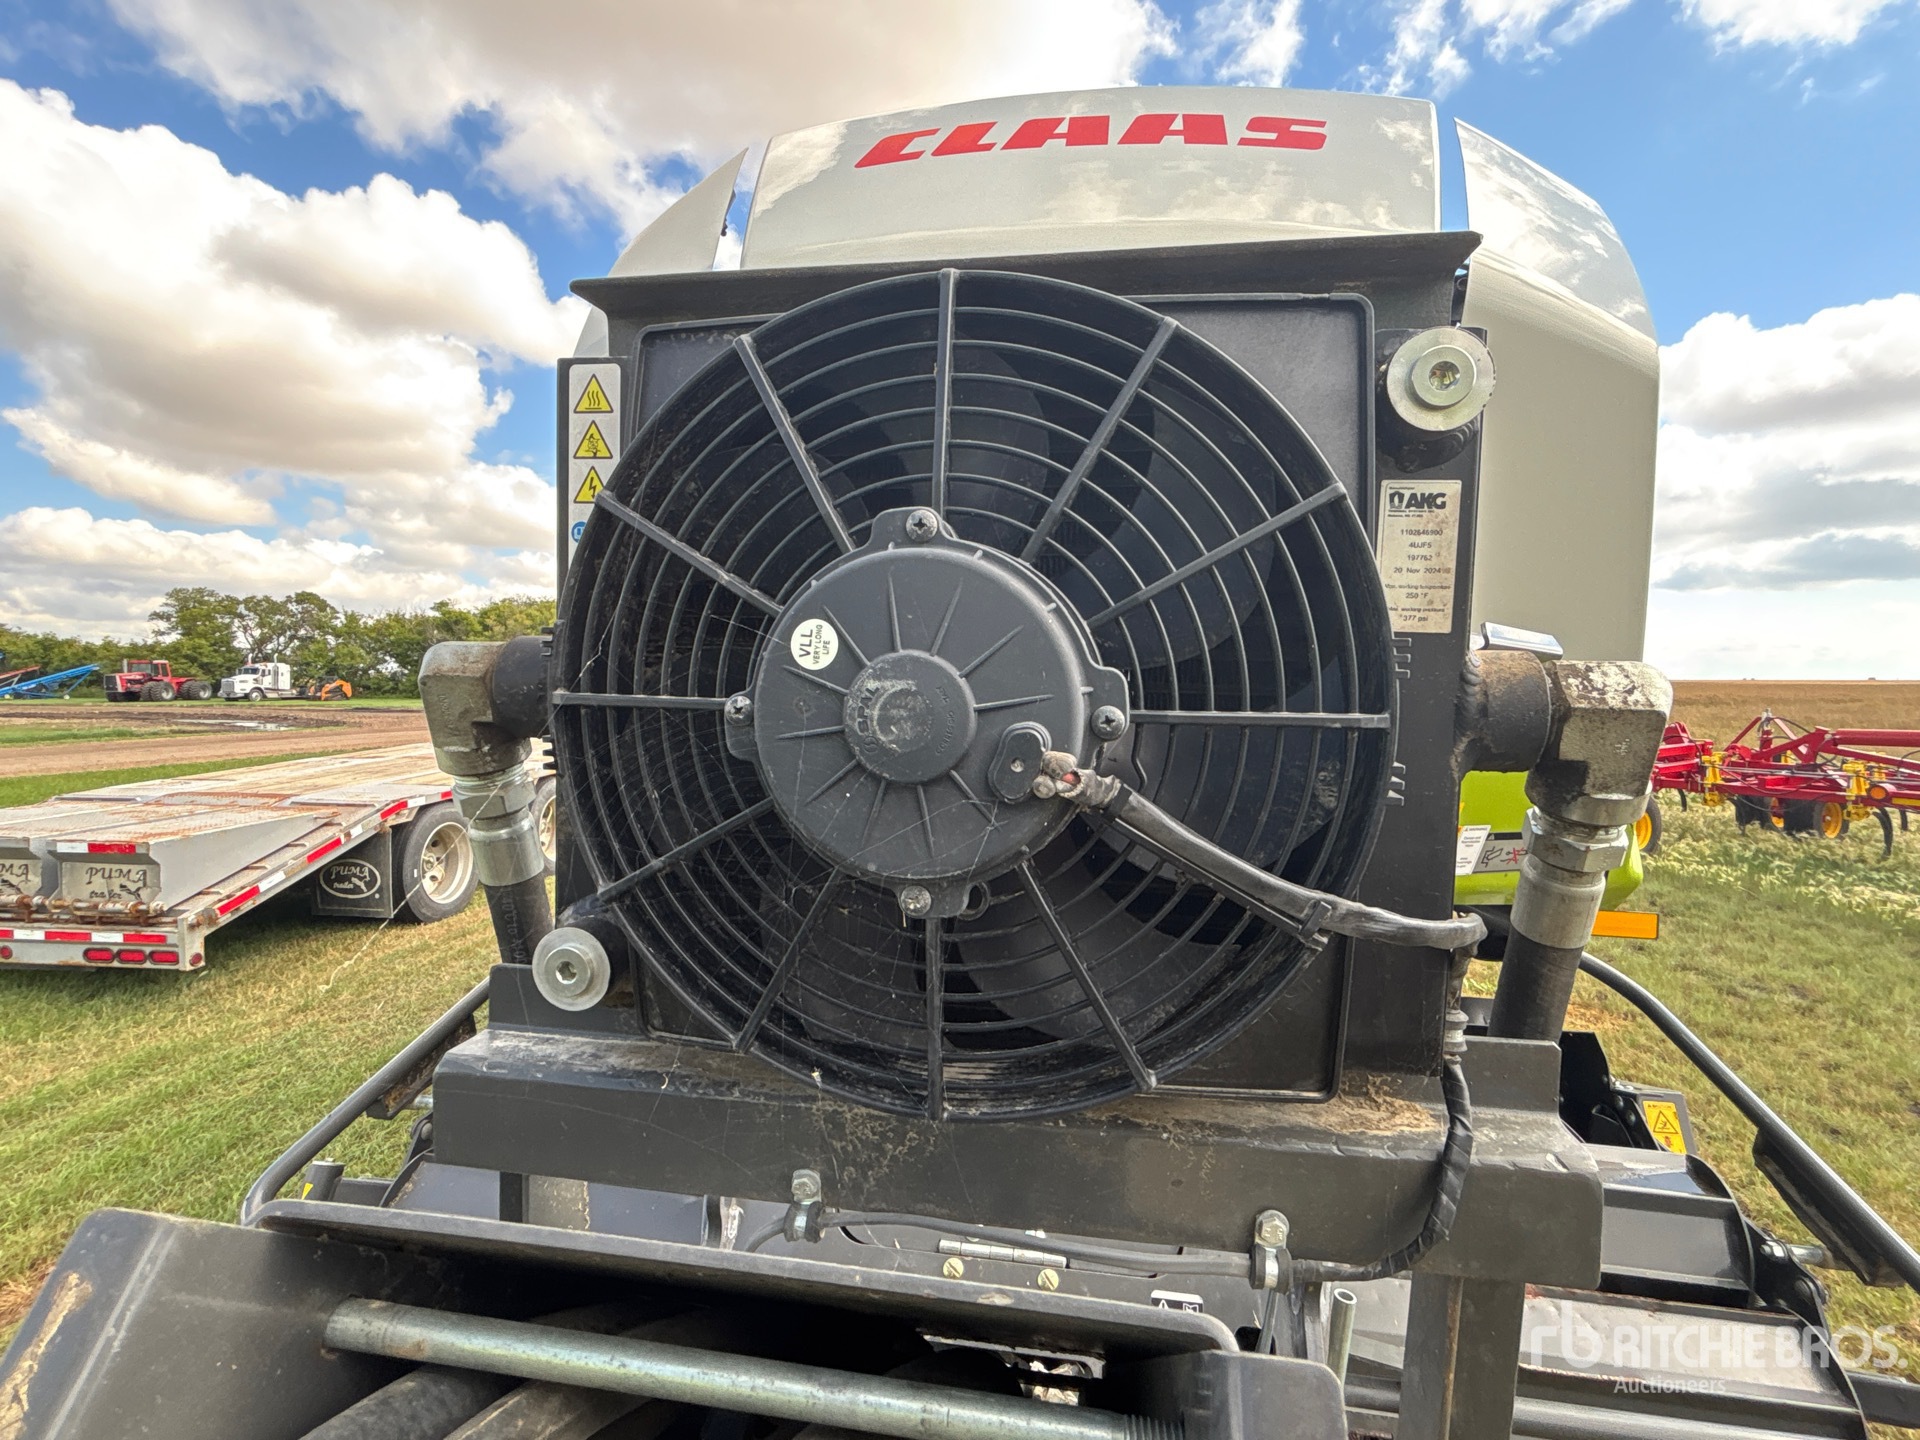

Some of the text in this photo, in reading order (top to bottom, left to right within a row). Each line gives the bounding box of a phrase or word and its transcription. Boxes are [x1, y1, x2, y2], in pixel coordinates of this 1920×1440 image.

[854, 113, 1327, 168] CLAAS
[1404, 492, 1447, 510] AKG
[798, 629, 813, 658] VLL
[812, 624, 823, 665] VERY LONG
[822, 640, 831, 655] LIFE
[85, 866, 148, 888] PUMA
[330, 865, 371, 881] PUMA
